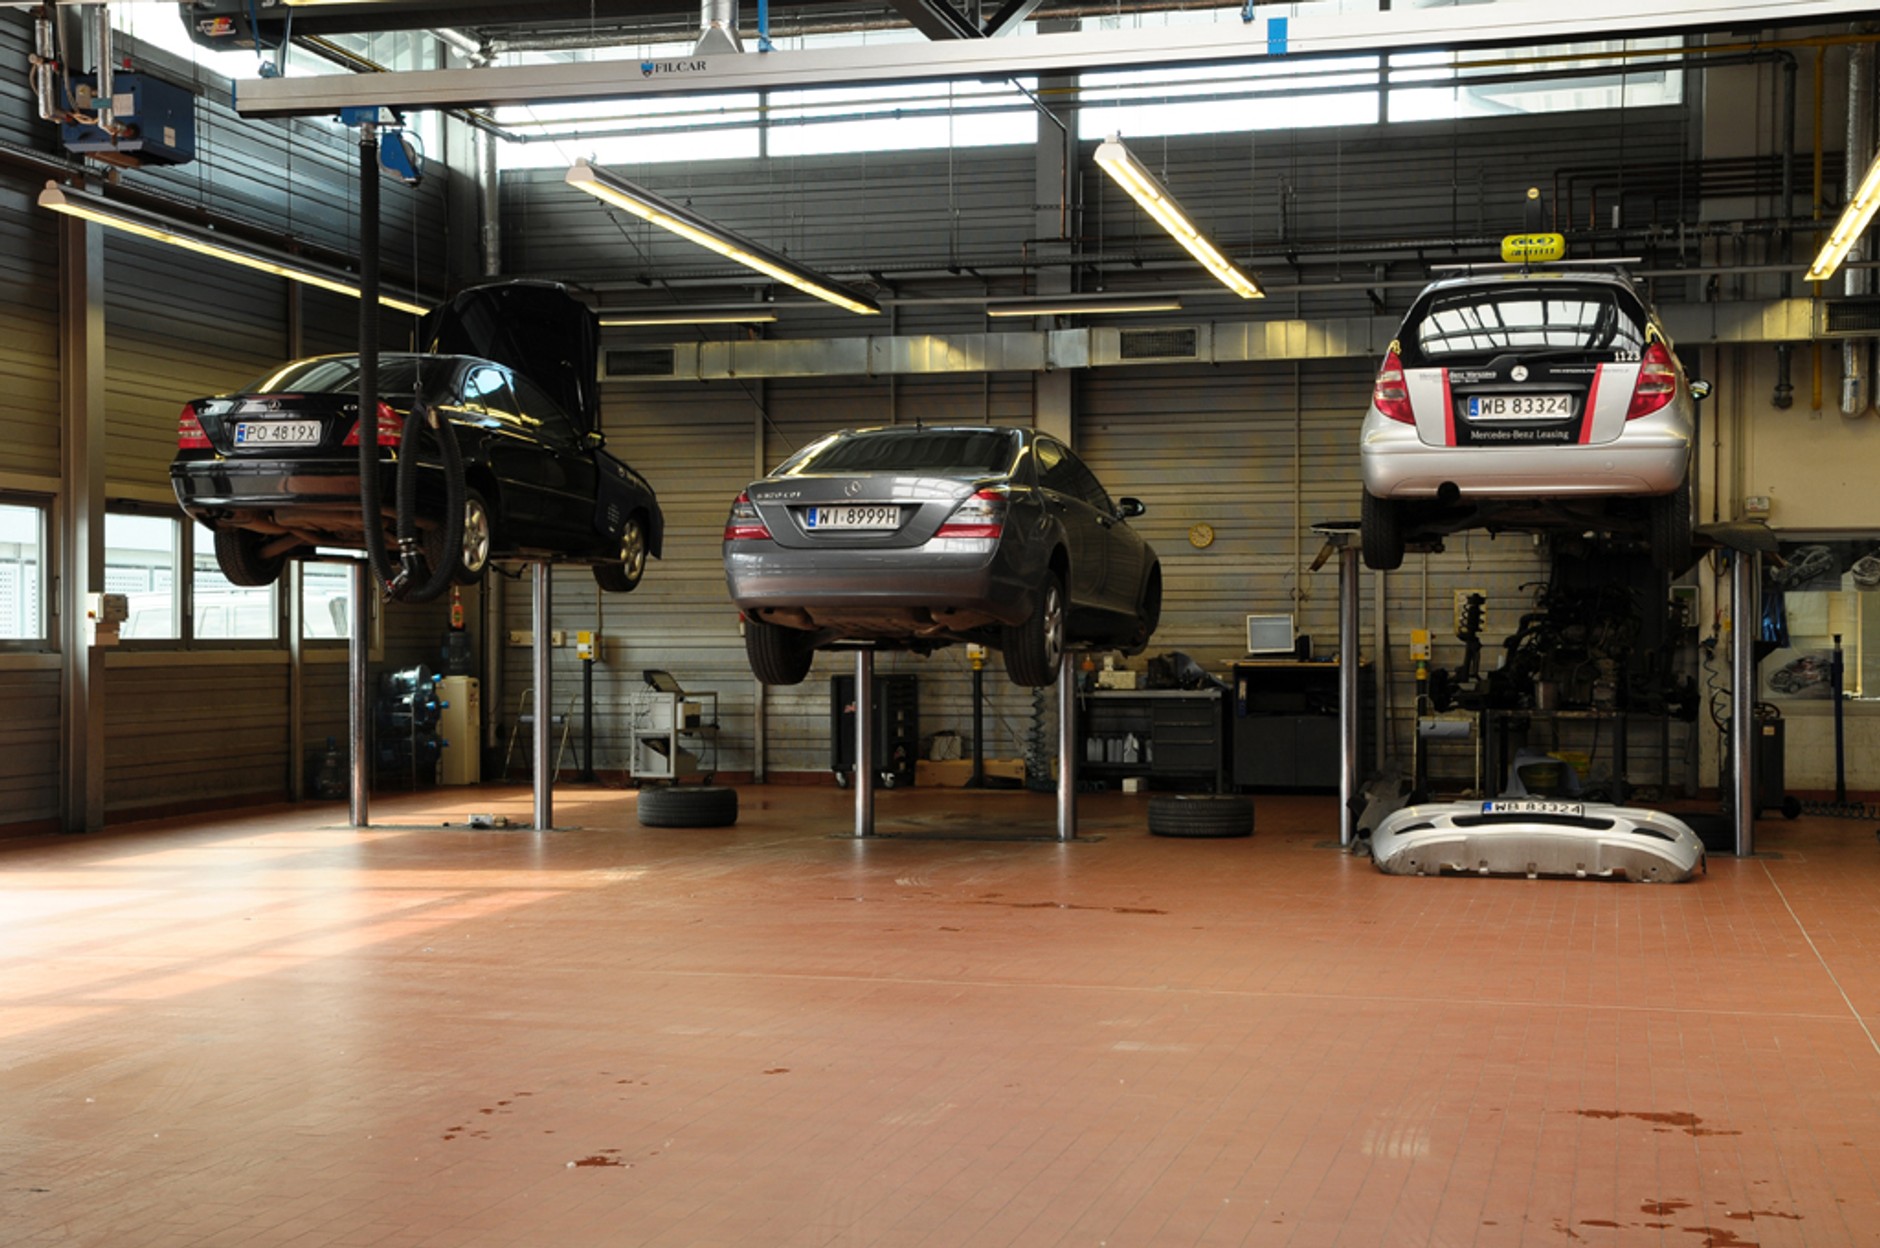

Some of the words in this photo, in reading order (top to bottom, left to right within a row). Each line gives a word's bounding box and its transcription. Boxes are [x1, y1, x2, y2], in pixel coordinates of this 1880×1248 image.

[655, 61, 706, 73] FILCAR
[1614, 350, 1641, 361] 1123
[1481, 399, 1506, 414] WB
[1512, 398, 1568, 414] 83324
[246, 426, 268, 440] PO
[272, 425, 315, 440] 4819X
[1470, 430, 1534, 440] Mercedes-Benz
[1536, 429, 1569, 440] Leasing
[819, 509, 838, 524] WI
[847, 508, 897, 524] 8999H
[1495, 802, 1519, 811] WB
[1525, 802, 1580, 814] 83324
